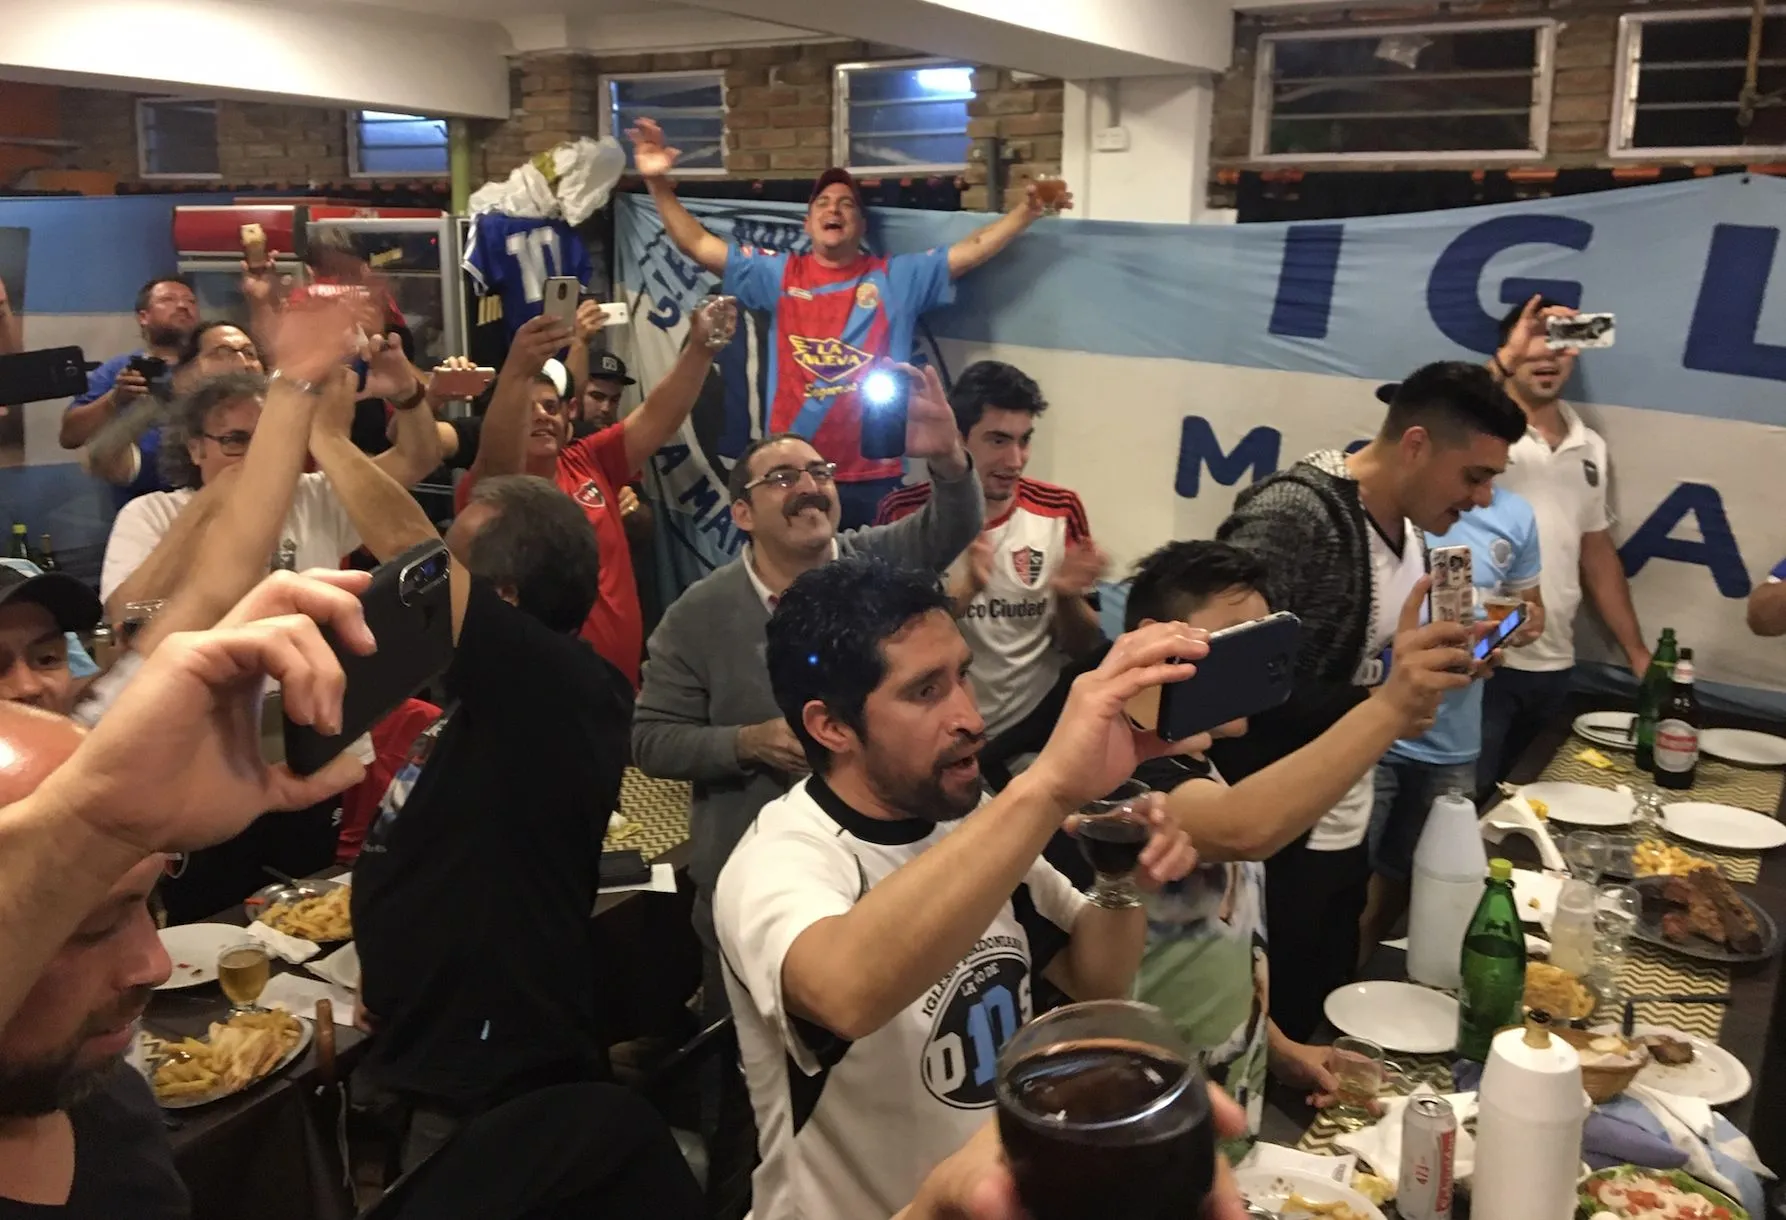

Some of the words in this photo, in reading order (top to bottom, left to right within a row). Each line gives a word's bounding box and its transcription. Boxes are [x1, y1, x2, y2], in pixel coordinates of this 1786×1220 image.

[505, 226, 562, 303] 10
[817, 343, 842, 354] LA
[802, 353, 862, 367] NUEVA
[989, 598, 1048, 618] Ciudad
